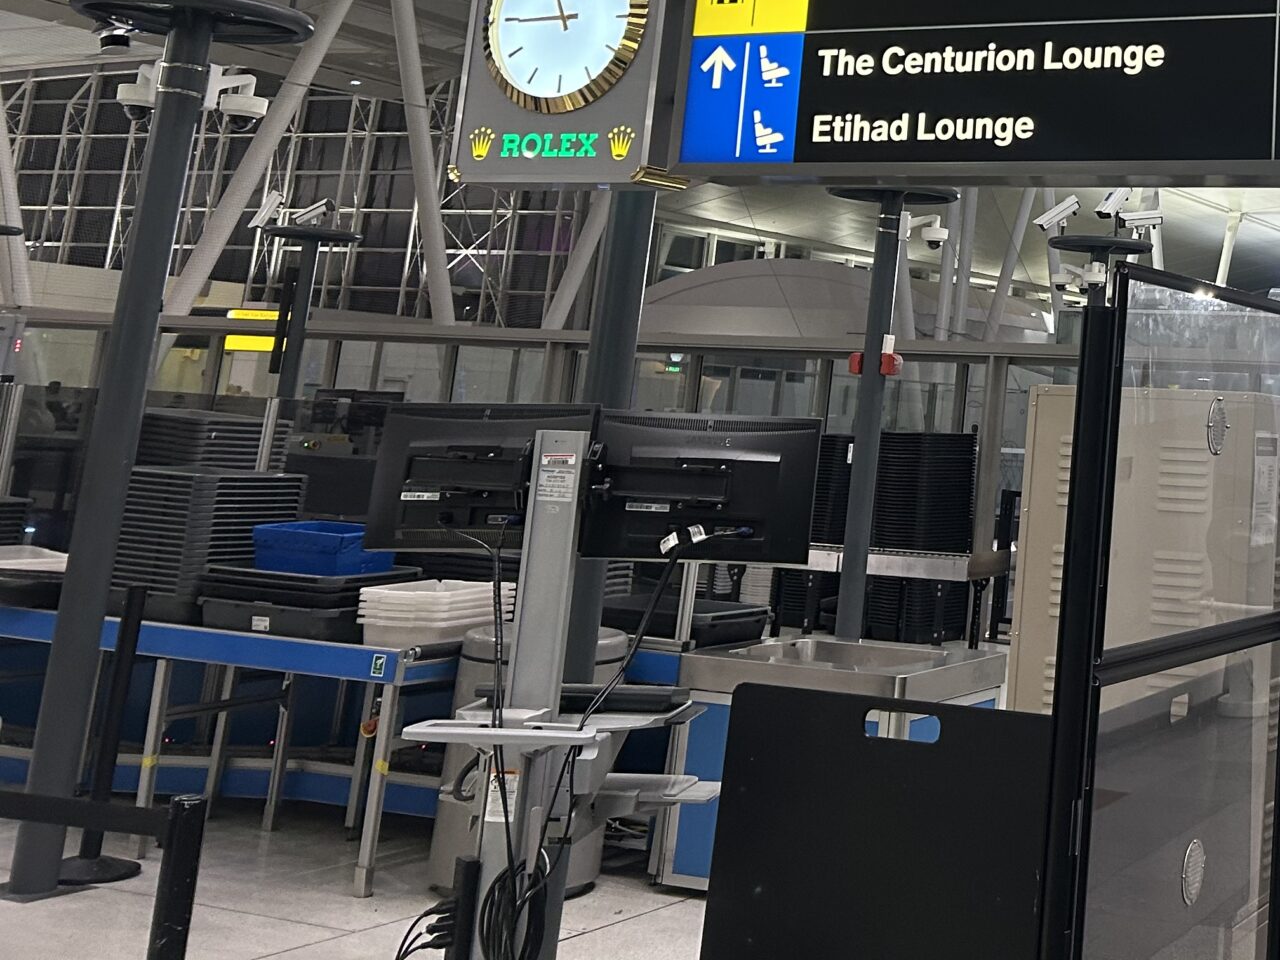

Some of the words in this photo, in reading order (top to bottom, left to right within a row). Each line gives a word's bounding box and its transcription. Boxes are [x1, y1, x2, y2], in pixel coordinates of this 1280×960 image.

[817, 48, 875, 77] The
[881, 42, 1035, 75] Centurion
[1043, 41, 1165, 75] Lounge
[500, 132, 599, 158] ROLEX
[812, 112, 910, 143] Etihad
[916, 112, 1035, 147] Lounge
